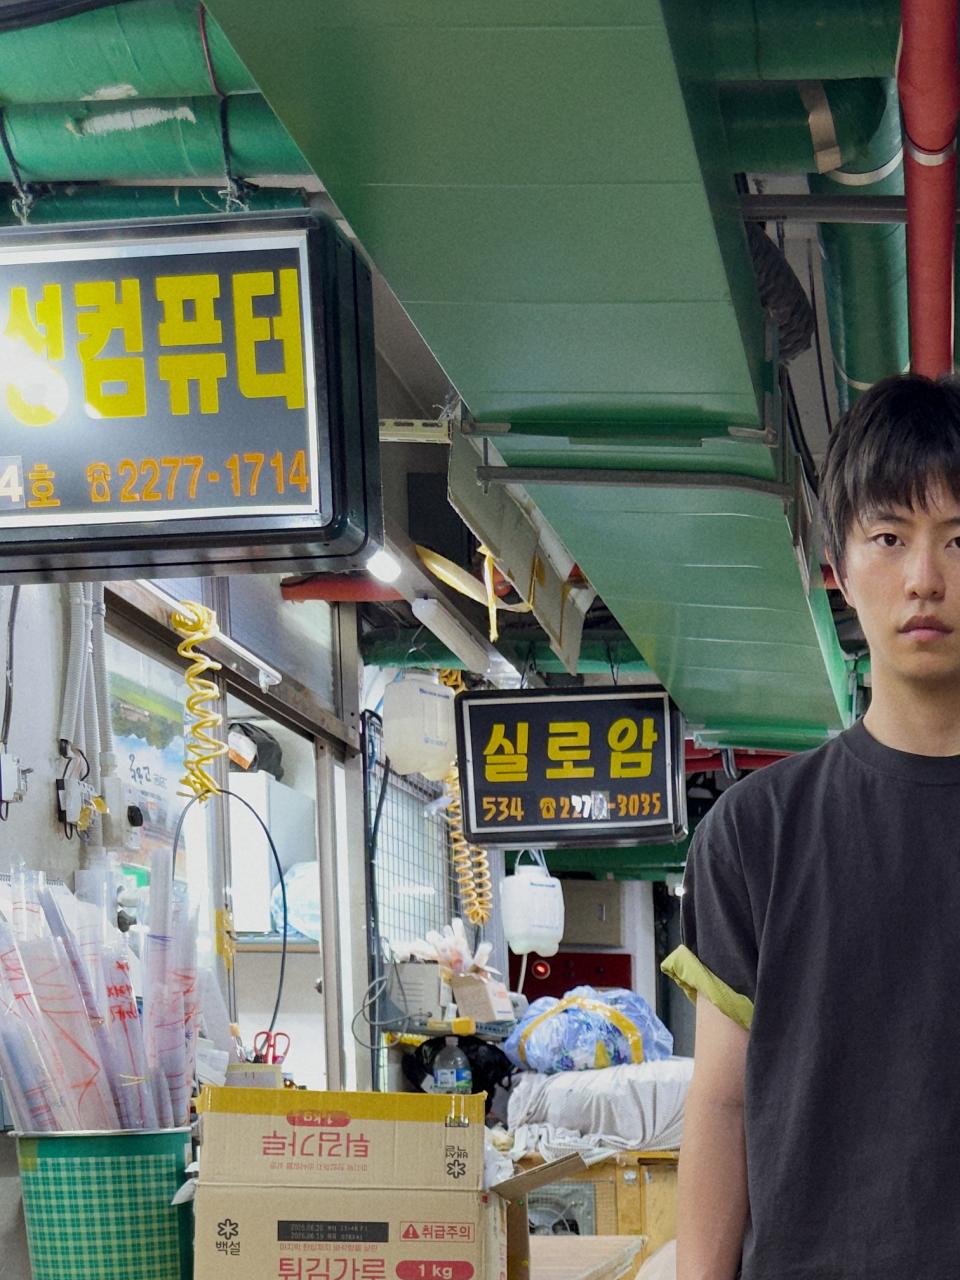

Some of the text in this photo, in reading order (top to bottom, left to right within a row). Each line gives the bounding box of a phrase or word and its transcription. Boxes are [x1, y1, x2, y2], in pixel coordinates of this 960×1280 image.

[118, 450, 309, 503] 2277-1714
[483, 718, 658, 782] 실로암
[482, 797, 524, 821] 534
[262, 1130, 370, 1158] 튀김가루
[421, 1225, 471, 1240] 취급주의
[215, 1240, 241, 1256] 백설
[431, 1263, 453, 1280] kg
